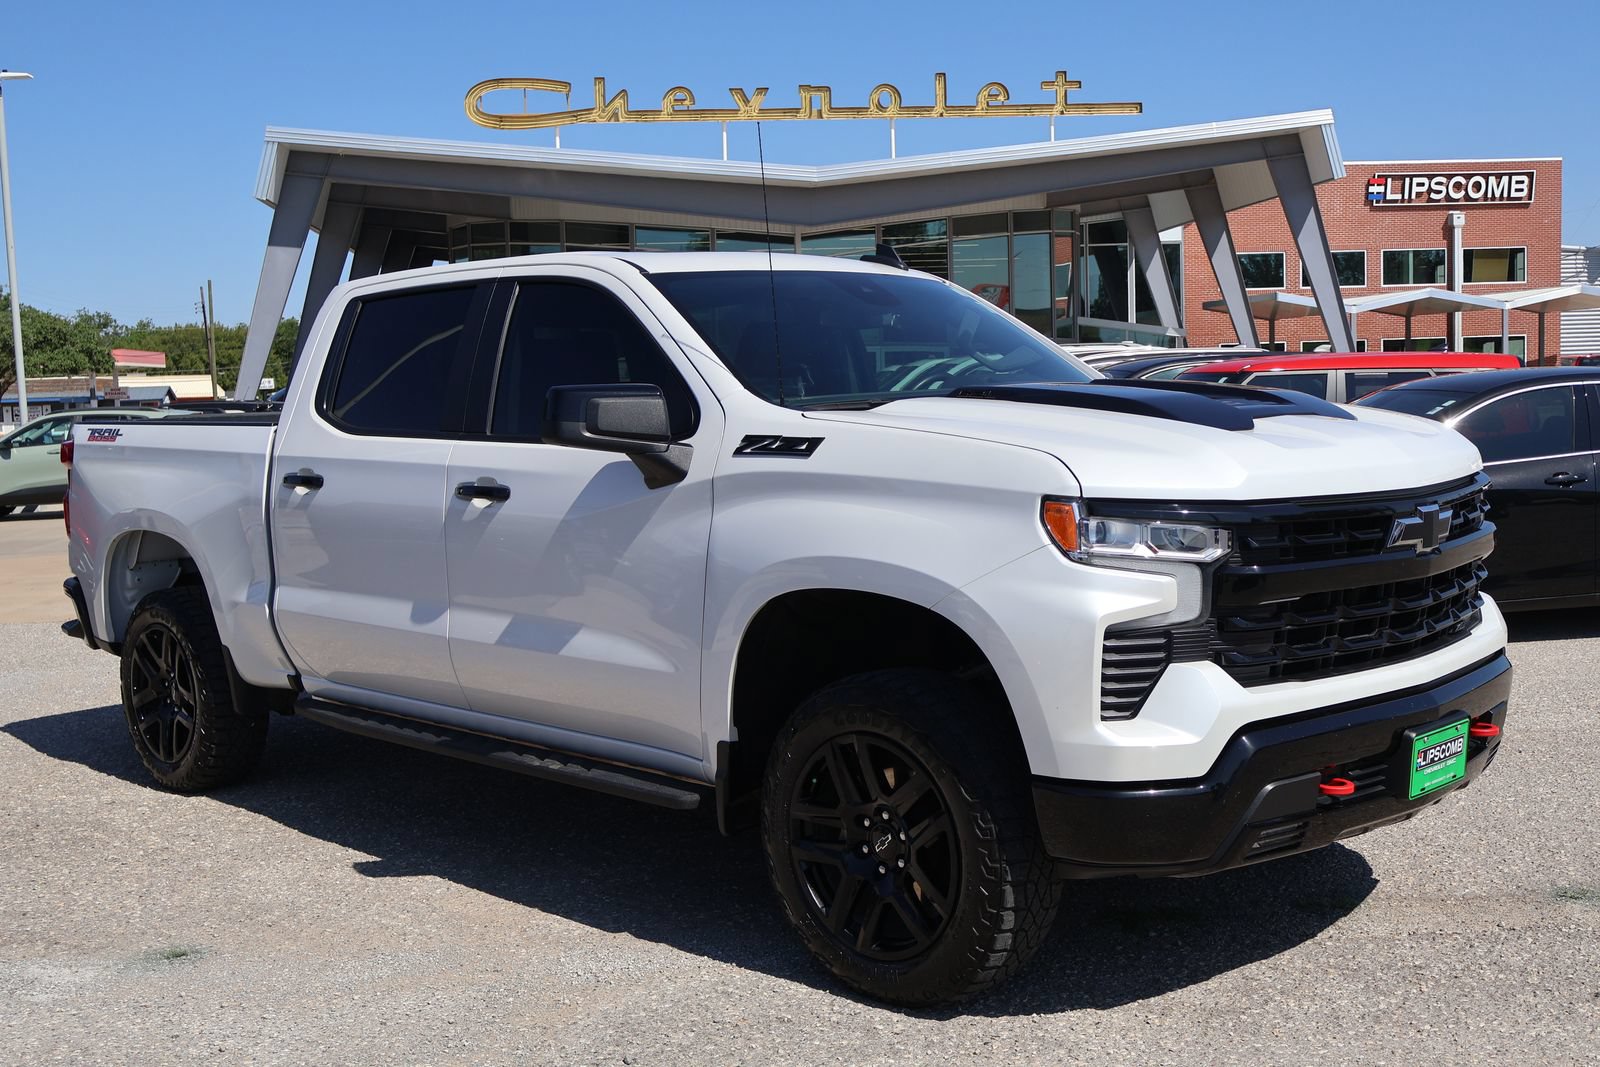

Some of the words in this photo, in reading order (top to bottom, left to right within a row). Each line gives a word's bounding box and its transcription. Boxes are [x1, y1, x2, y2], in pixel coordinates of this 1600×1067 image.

[465, 71, 1143, 130] Chevrolet
[1385, 175, 1529, 200] LIPSCOMB
[87, 428, 123, 436] TRAIL
[1420, 737, 1464, 766] LIPSCOMB
